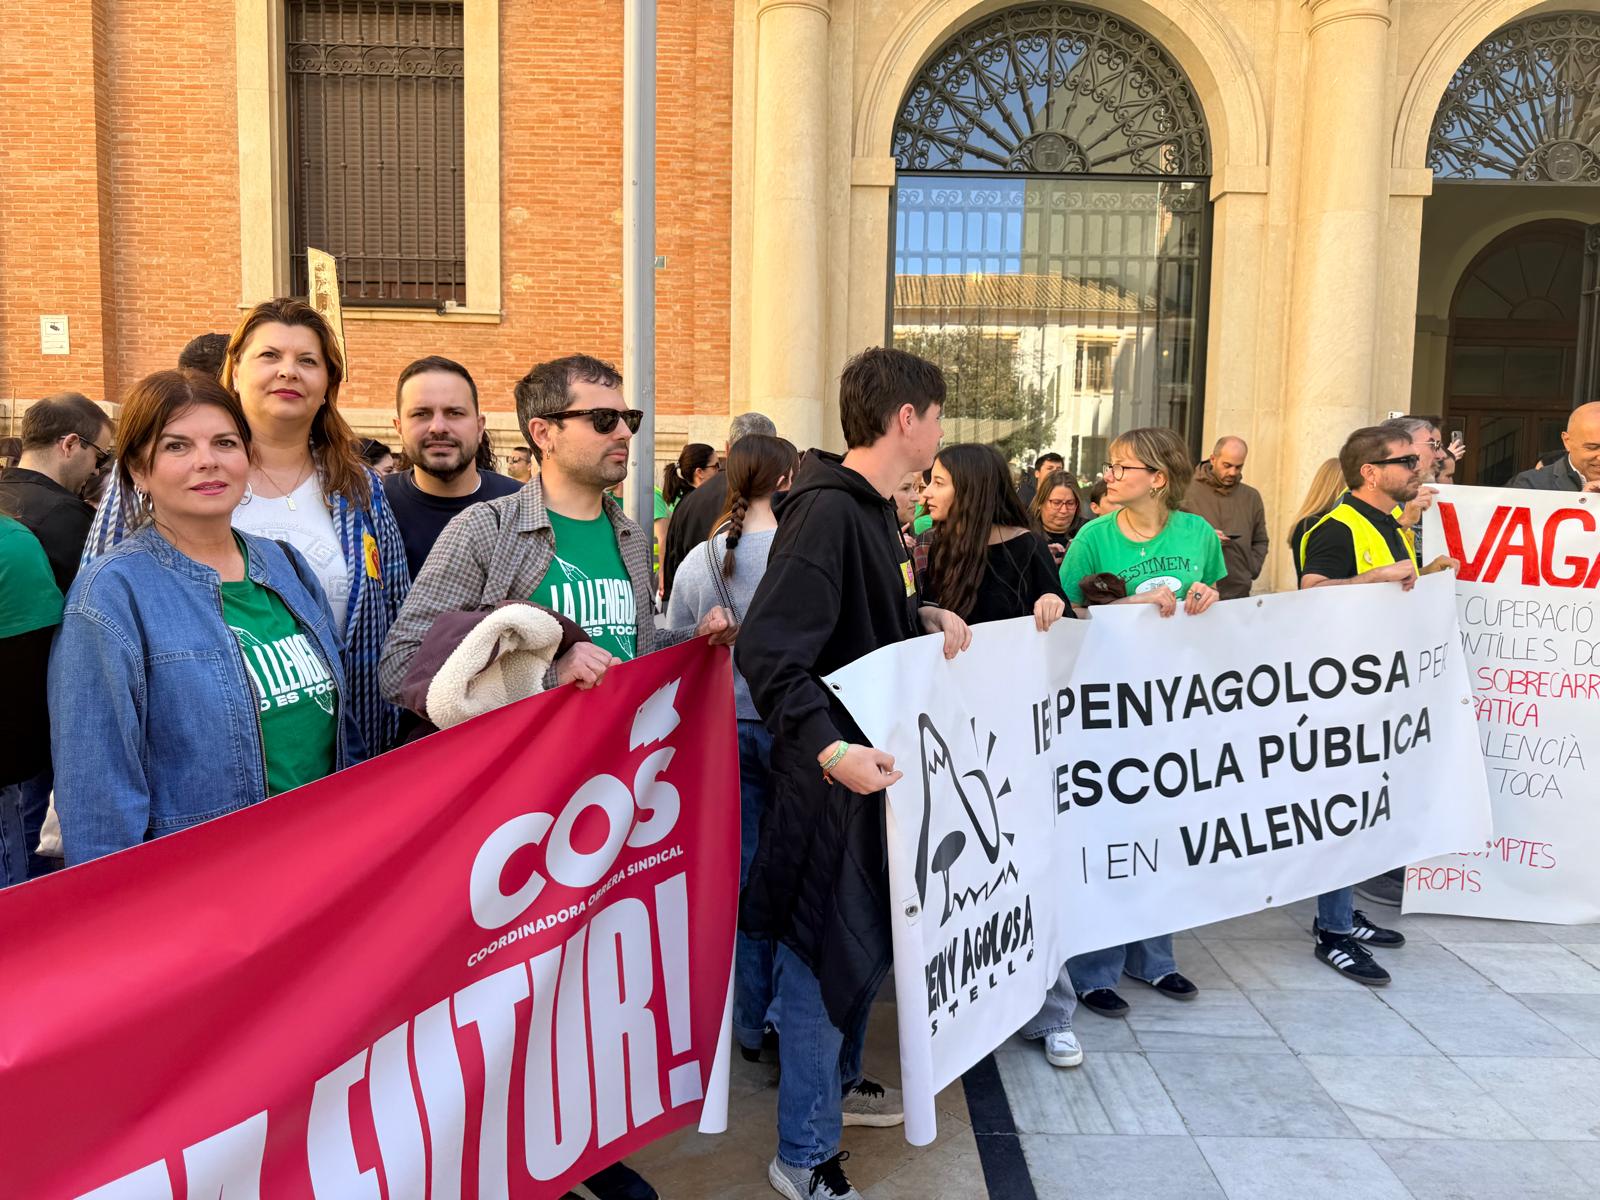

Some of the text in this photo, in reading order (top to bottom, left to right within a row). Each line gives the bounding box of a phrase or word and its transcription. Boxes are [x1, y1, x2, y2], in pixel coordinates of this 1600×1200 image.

[1437, 501, 1600, 589] VAG
[1118, 555, 1190, 583] ESTIMEM
[1456, 593, 1593, 633] CUPERACIÓ
[1460, 631, 1558, 663] NTILLES
[275, 691, 300, 707] ES
[304, 679, 336, 698] TOC
[1032, 693, 1052, 755] IE
[1056, 650, 1409, 735] PENYAGOLOSA
[1477, 666, 1600, 699] SOBRECÀRR
[1053, 706, 1432, 815] ESCOLA PÚBLICA
[1481, 731, 1585, 771] LENCIÀ
[1492, 767, 1563, 799] TOCA
[469, 746, 681, 930] COS
[1081, 771, 1391, 884] I EN VALENCIÀ
[1485, 836, 1557, 869] MPTES
[467, 844, 684, 967] COORDINADORA OBRERA SINDICAL
